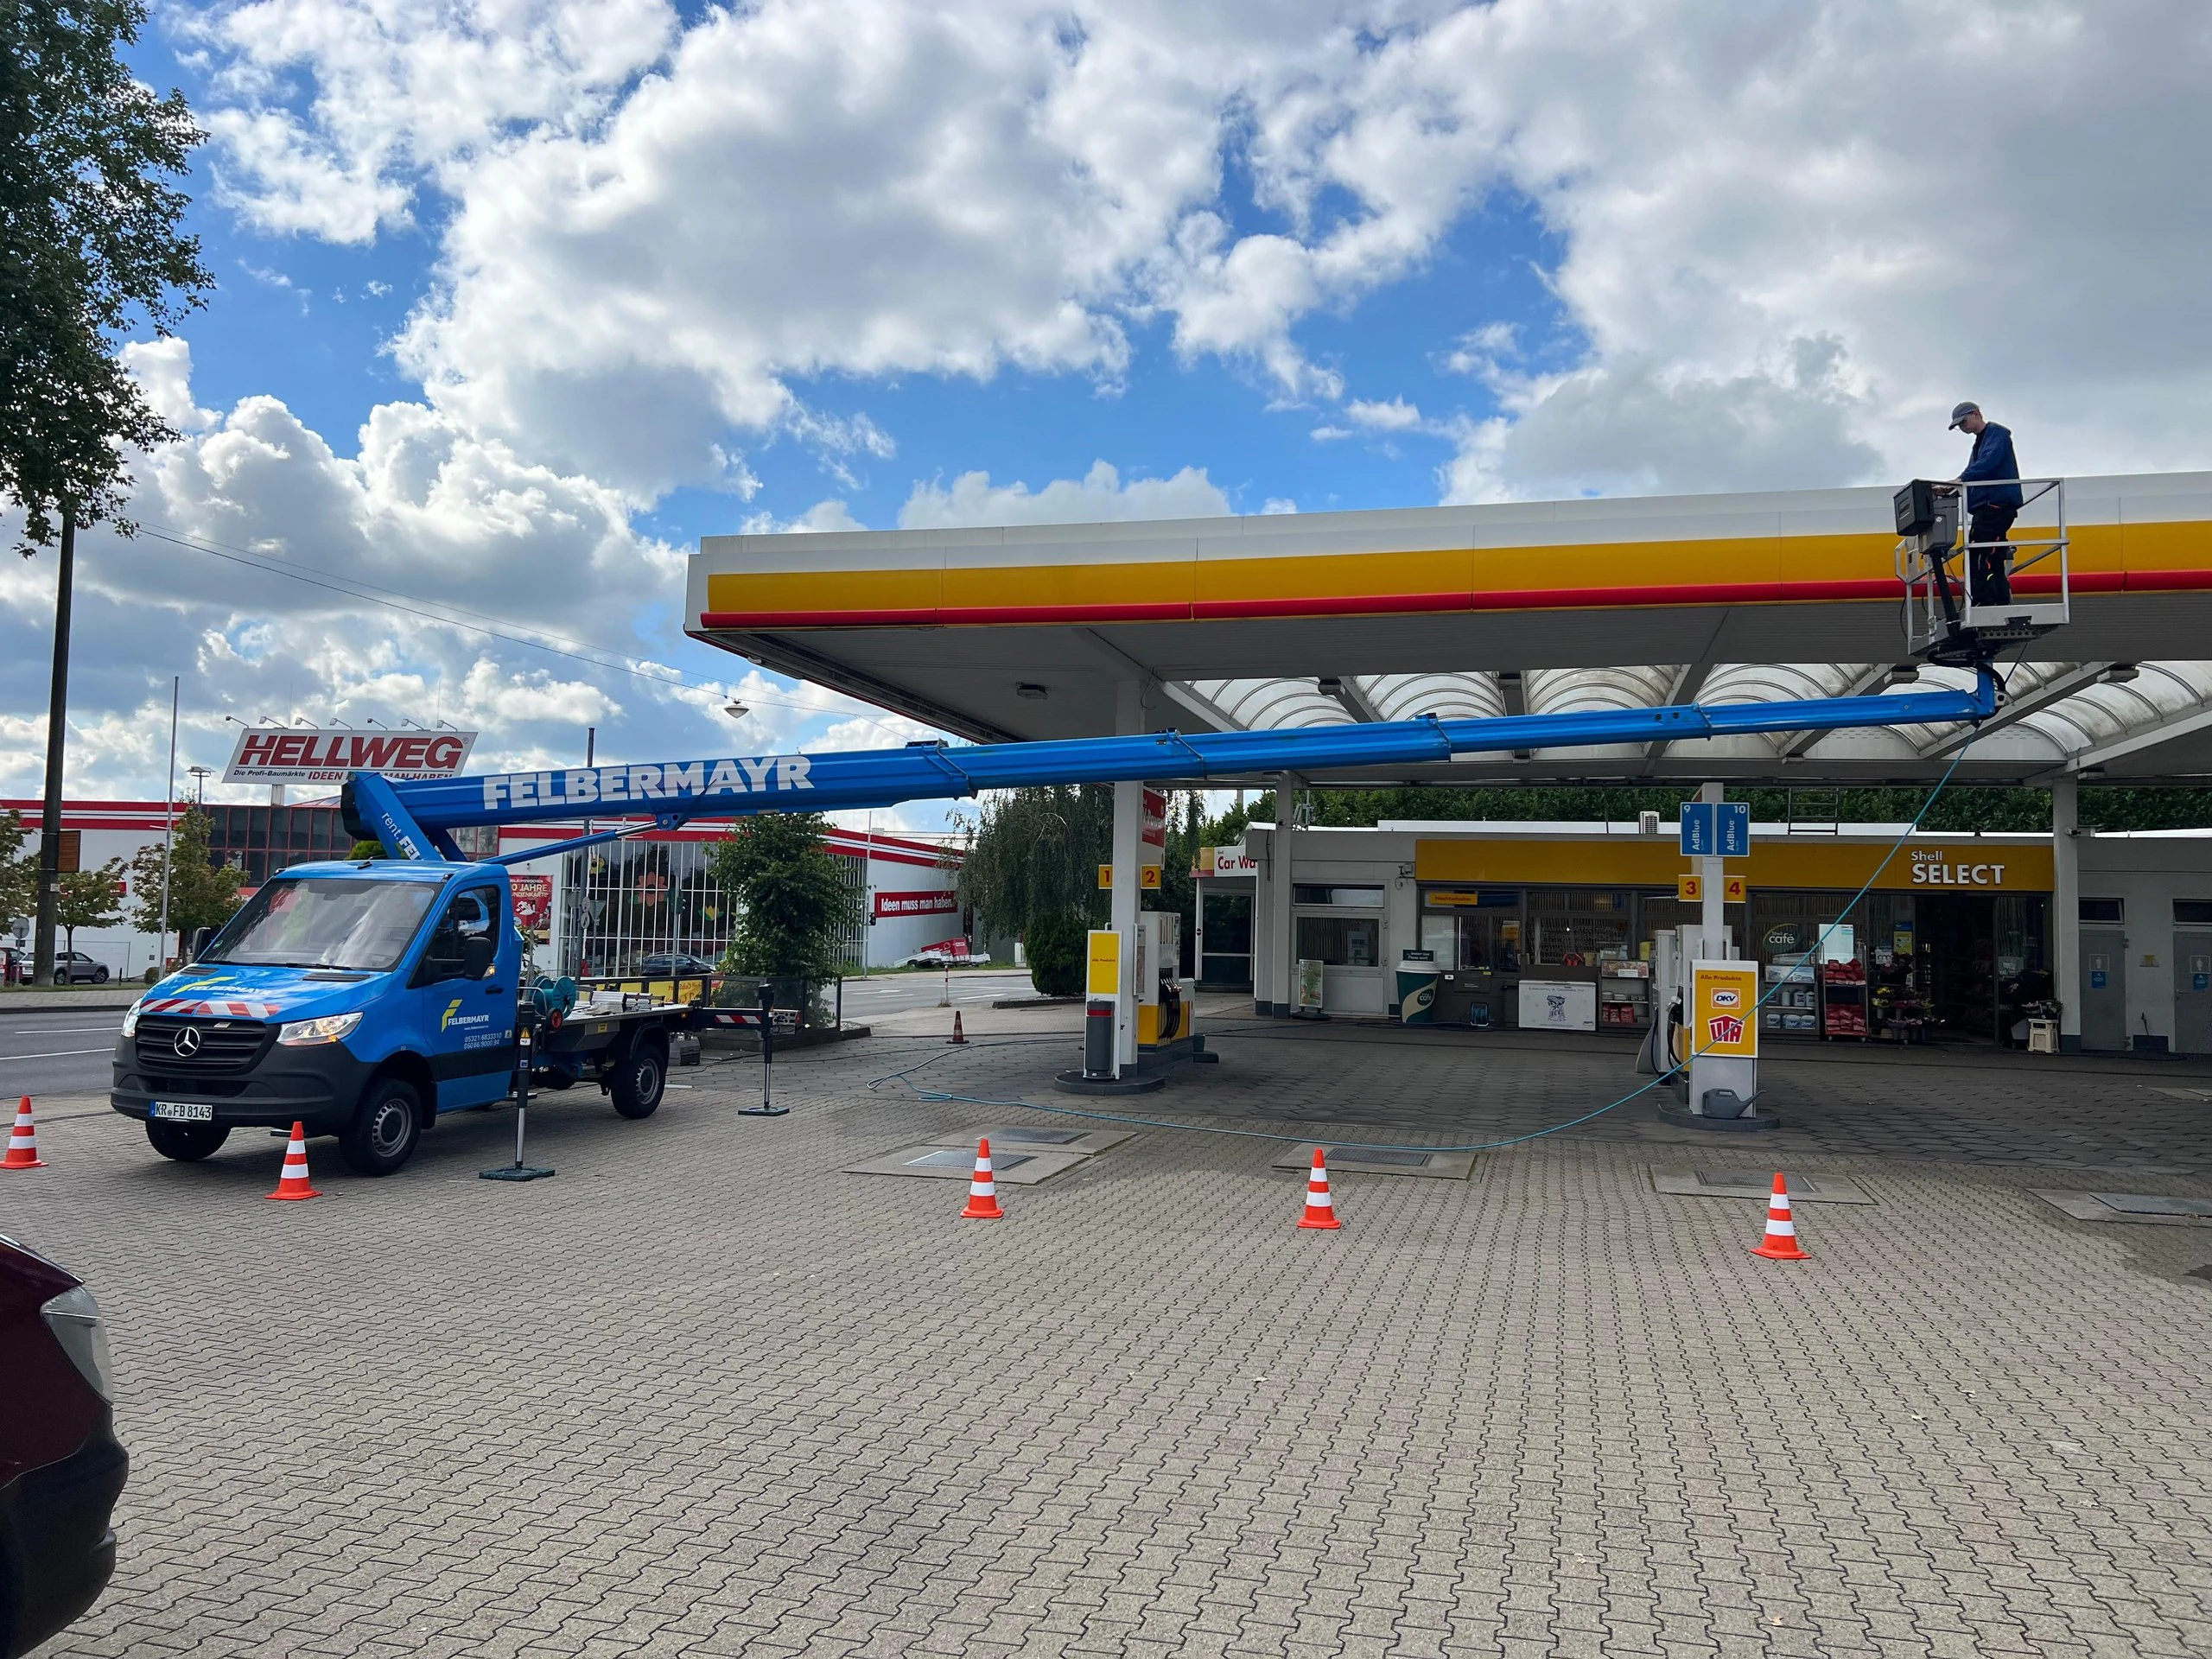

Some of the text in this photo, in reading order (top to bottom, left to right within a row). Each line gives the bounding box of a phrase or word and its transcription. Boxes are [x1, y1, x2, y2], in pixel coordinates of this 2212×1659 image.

[238, 734, 463, 769] HELLWEG
[308, 771, 343, 781] IDEEN
[483, 755, 815, 810] FELBERMAYR
[1683, 804, 1691, 813] 9
[1733, 805, 1746, 814] 10
[1692, 818, 1700, 850] AdBlue
[1726, 820, 1735, 851] AdBlue
[1217, 855, 1236, 870] Car
[1910, 850, 1943, 861] Shell
[1104, 870, 1109, 883] 1
[1146, 870, 1155, 883] 2
[1912, 863, 2005, 885] SELECT
[519, 883, 548, 892] JAHRE
[1685, 881, 1697, 895] 3
[1728, 881, 1741, 895] 4
[881, 898, 900, 912] Ideen
[901, 900, 918, 911] muss
[919, 899, 933, 909] man
[448, 1014, 490, 1026] FELBERMAYR
[156, 1103, 212, 1118] KR FB 8143
